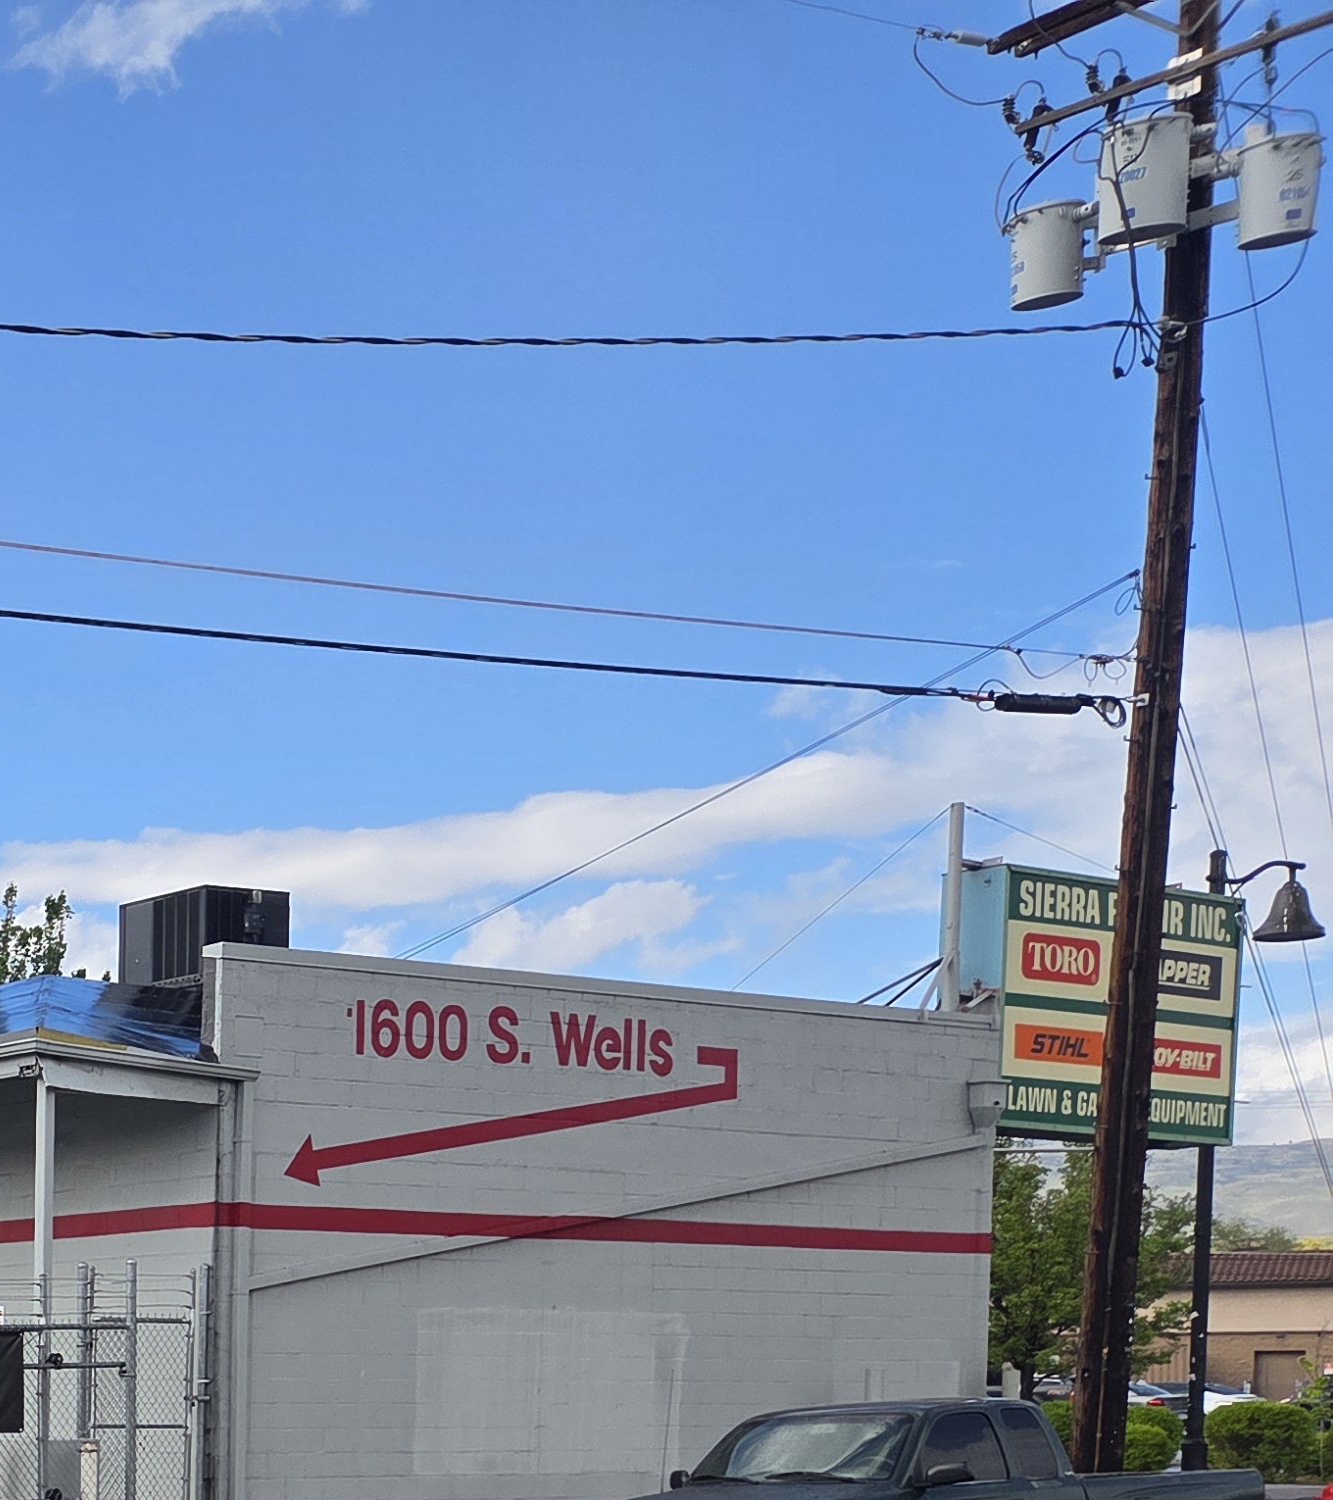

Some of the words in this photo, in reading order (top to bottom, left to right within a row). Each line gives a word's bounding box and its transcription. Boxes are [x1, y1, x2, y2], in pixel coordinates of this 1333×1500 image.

[1019, 879, 1101, 924] SIERRA
[1190, 903, 1232, 943] INC.
[1028, 941, 1096, 976] TORO
[1159, 958, 1212, 986] PPER
[347, 998, 468, 1062] 1600
[485, 1005, 530, 1064] S.
[549, 1011, 674, 1077] Wells
[1030, 1033, 1089, 1058] STIHL
[1153, 1046, 1219, 1072] OY-BILT
[1008, 1084, 1057, 1114] LAWN
[1061, 1089, 1072, 1115] &
[1148, 1097, 1227, 1128] QUIPMENT
